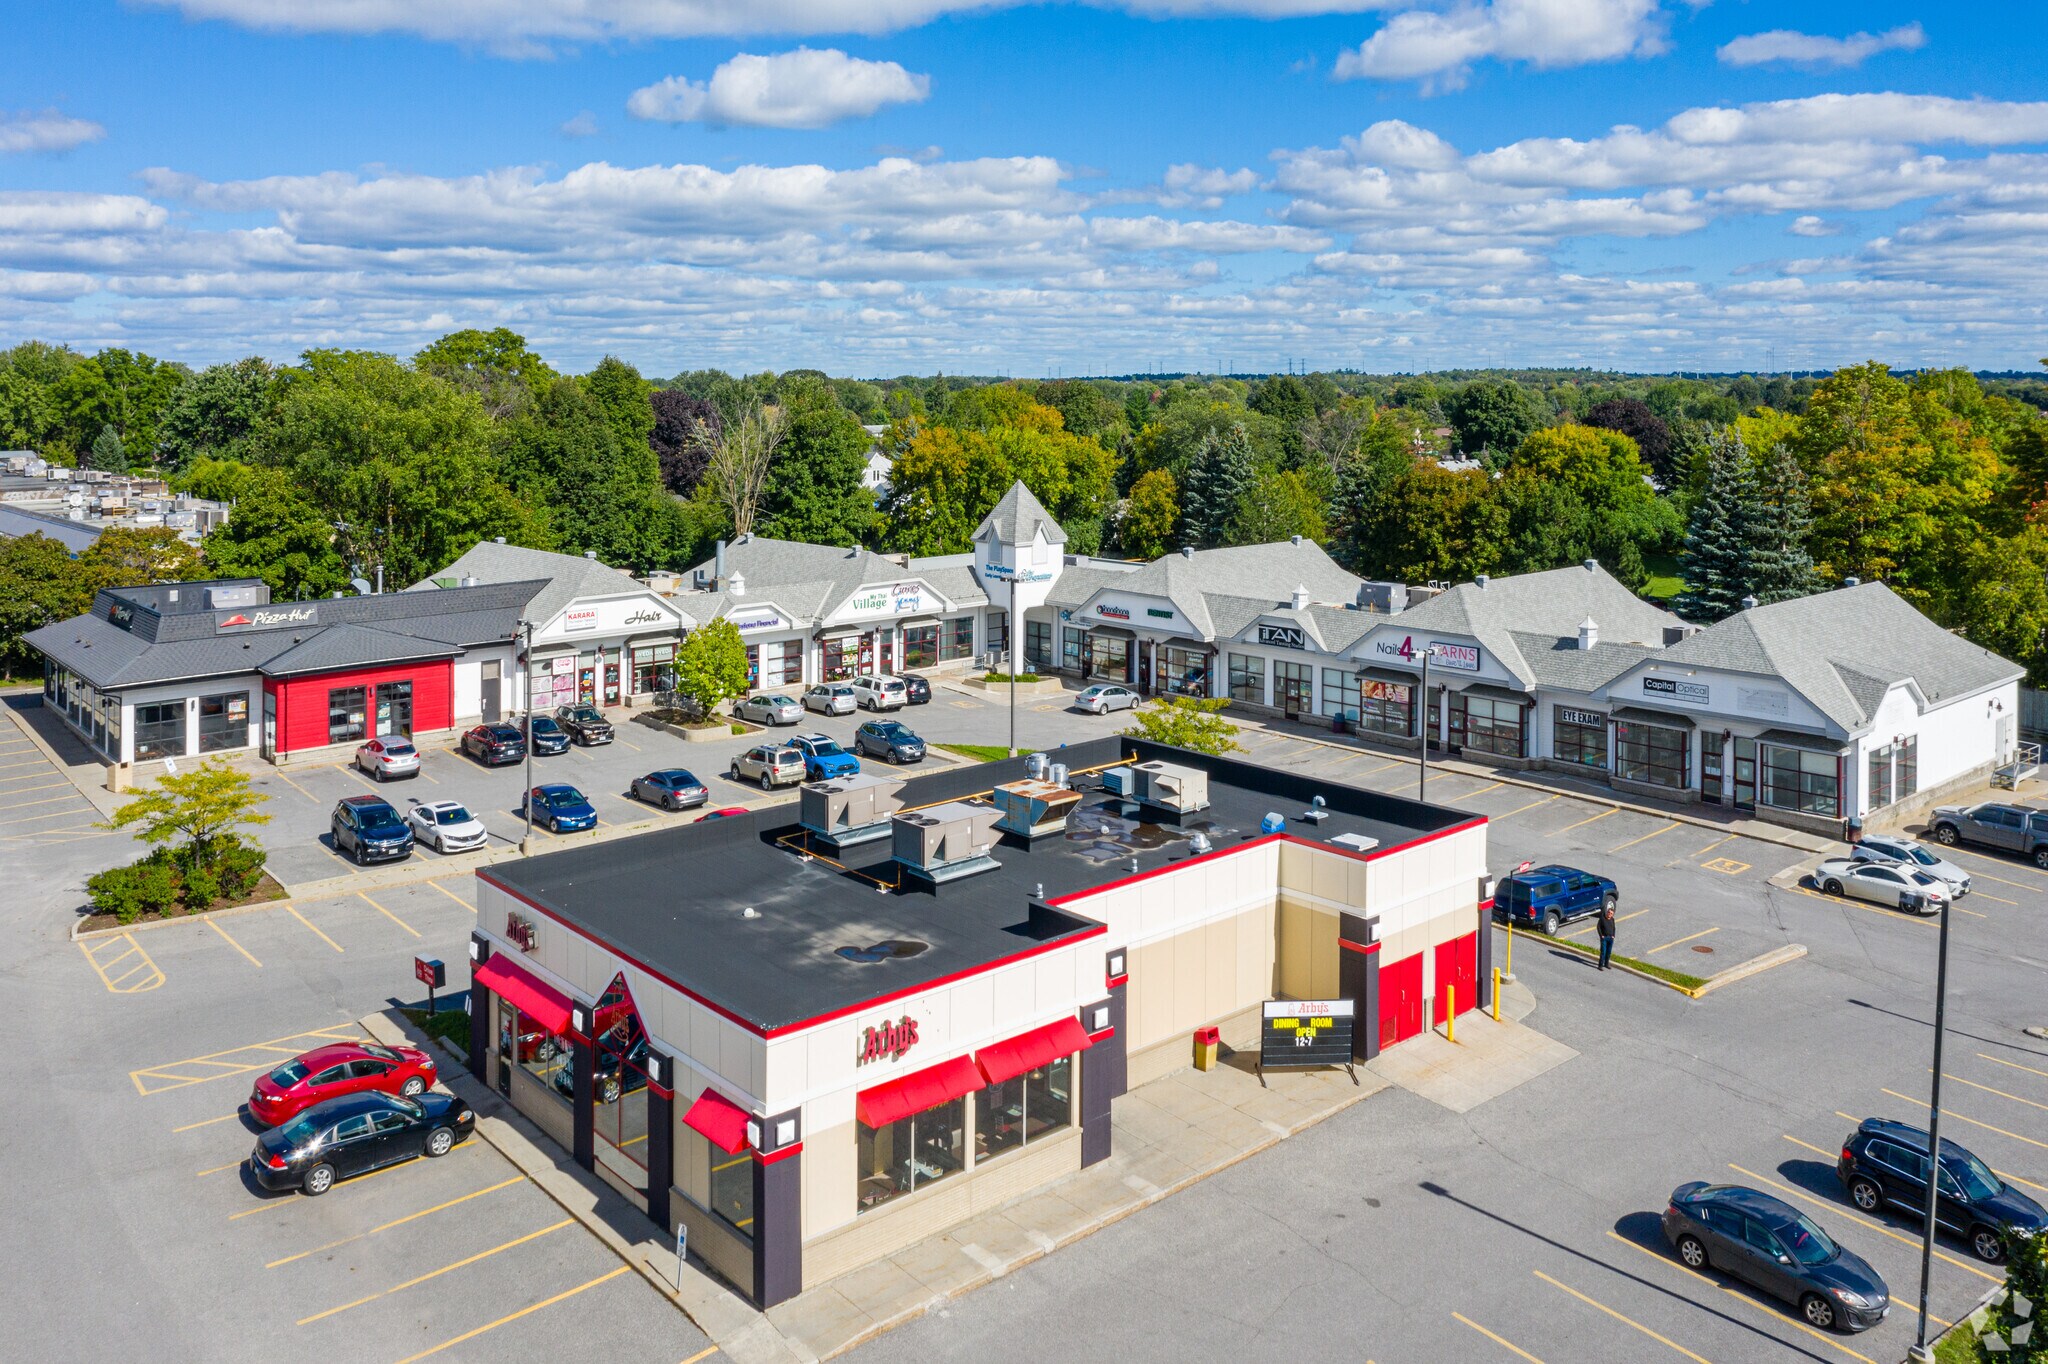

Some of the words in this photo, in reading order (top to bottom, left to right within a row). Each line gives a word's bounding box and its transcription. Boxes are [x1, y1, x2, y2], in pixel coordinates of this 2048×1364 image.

[853, 598, 887, 610] Village
[252, 611, 288, 627] Pizza
[288, 608, 315, 622] Hut
[567, 611, 595, 620] KARARA
[624, 609, 662, 624] Hair
[1376, 642, 1401, 656] Nails
[1400, 635, 1412, 662] 4
[1645, 679, 1675, 691] Capital
[1677, 683, 1708, 696] Optical
[1563, 710, 1577, 722] EYE
[1578, 712, 1600, 726] EXAM
[1298, 1002, 1329, 1016] Arby's
[1273, 1017, 1300, 1029] DINING
[1310, 1016, 1333, 1028] ROOM
[861, 1015, 920, 1064] Arby's
[1296, 1027, 1317, 1037] OPEN
